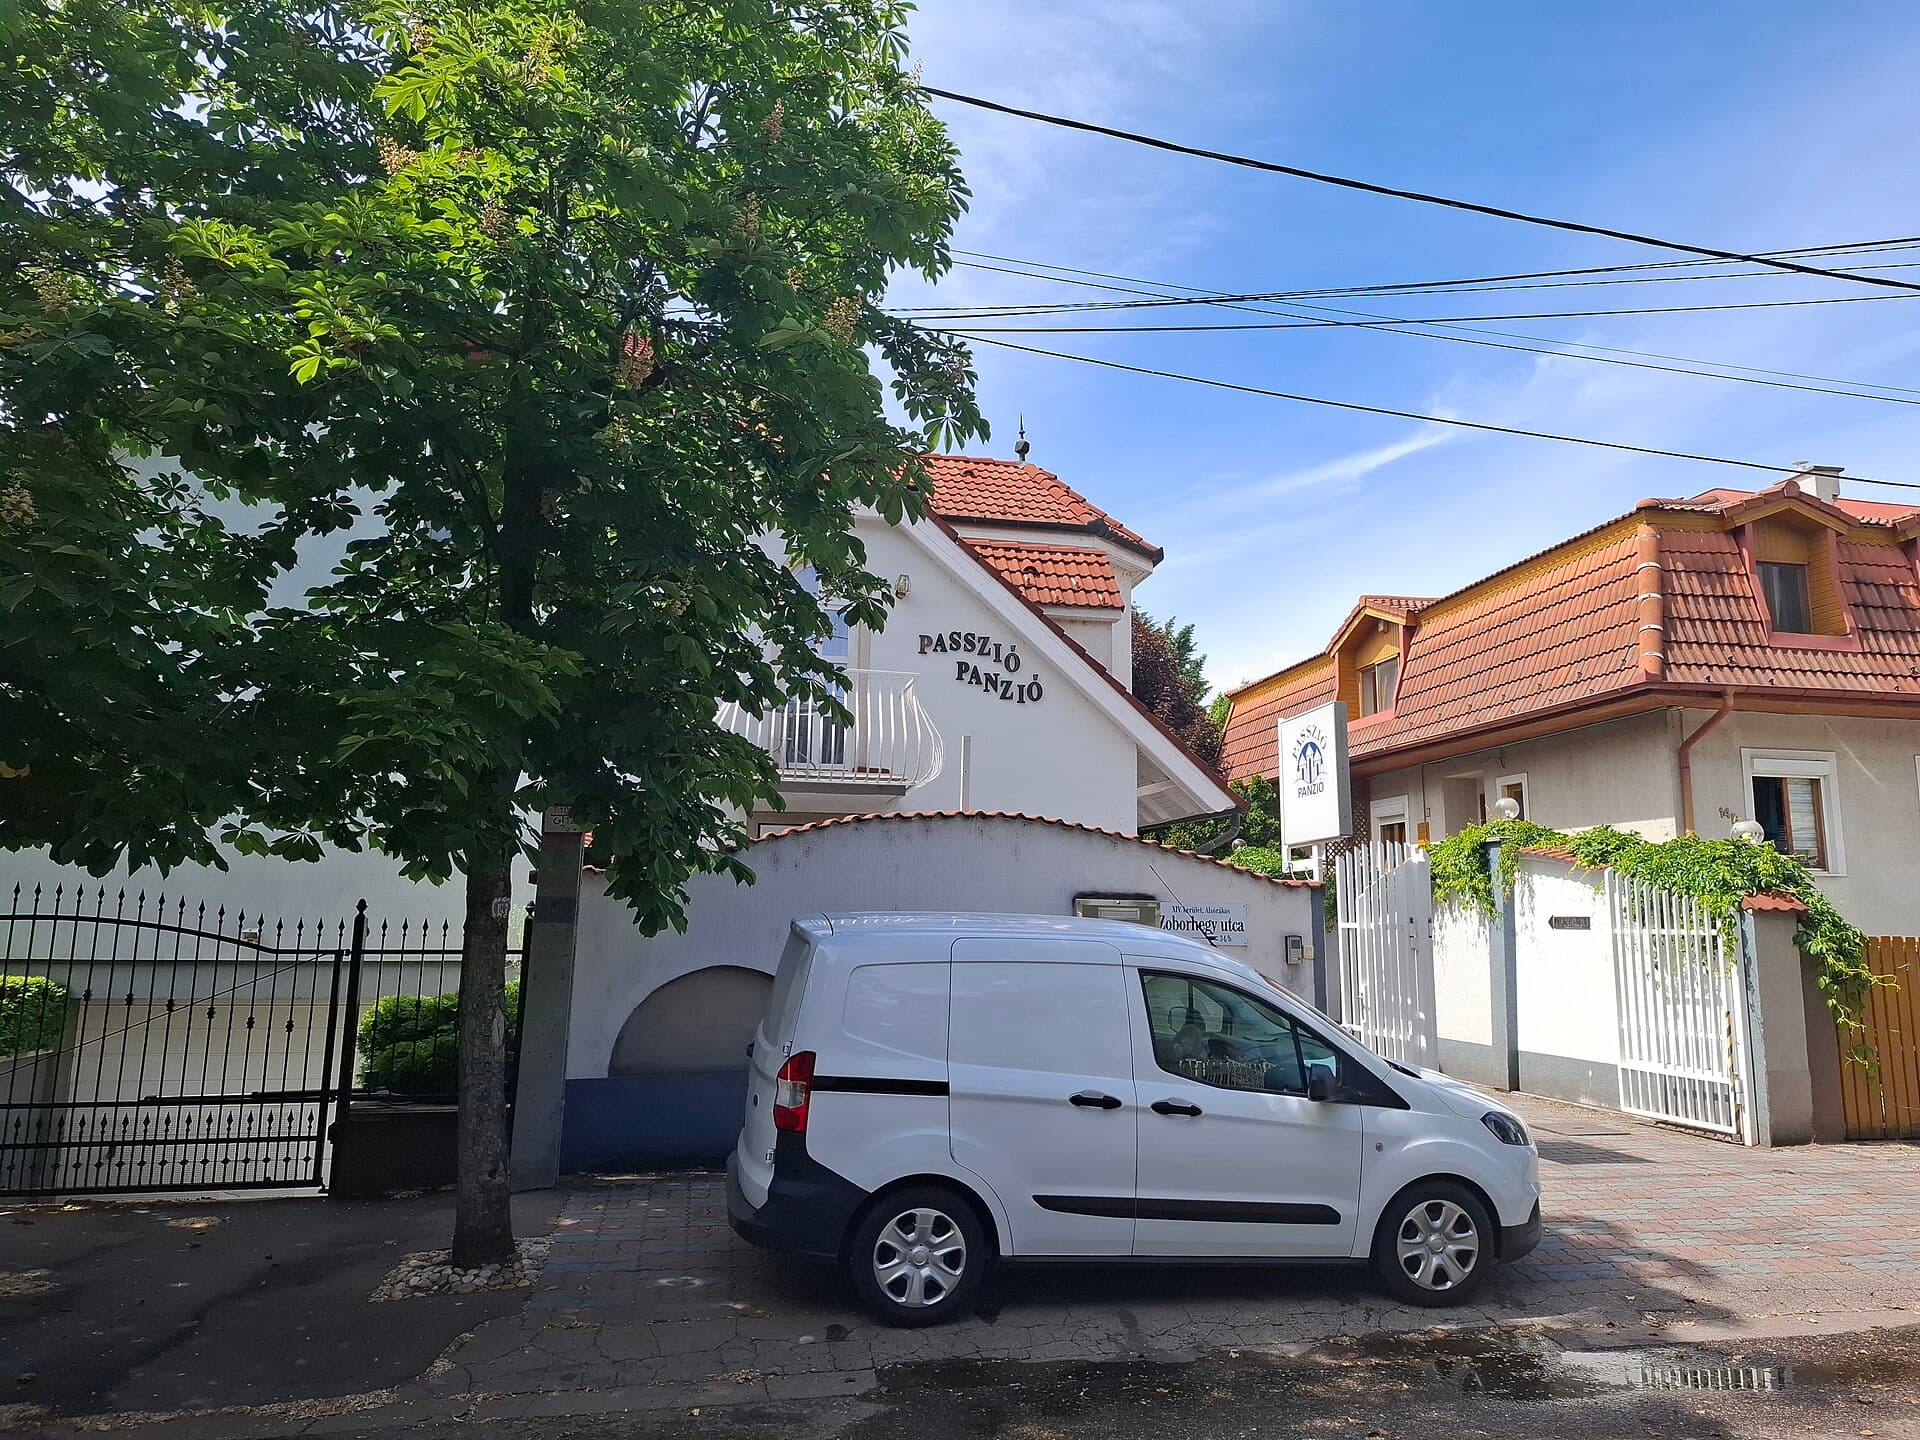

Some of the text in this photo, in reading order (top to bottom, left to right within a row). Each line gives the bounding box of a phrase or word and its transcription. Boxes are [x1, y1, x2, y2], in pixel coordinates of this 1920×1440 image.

[918, 631, 1021, 672] PASSZIÓ
[956, 661, 1043, 703] PANZIÓ
[1160, 915, 1244, 934] Zoborhegy utca
